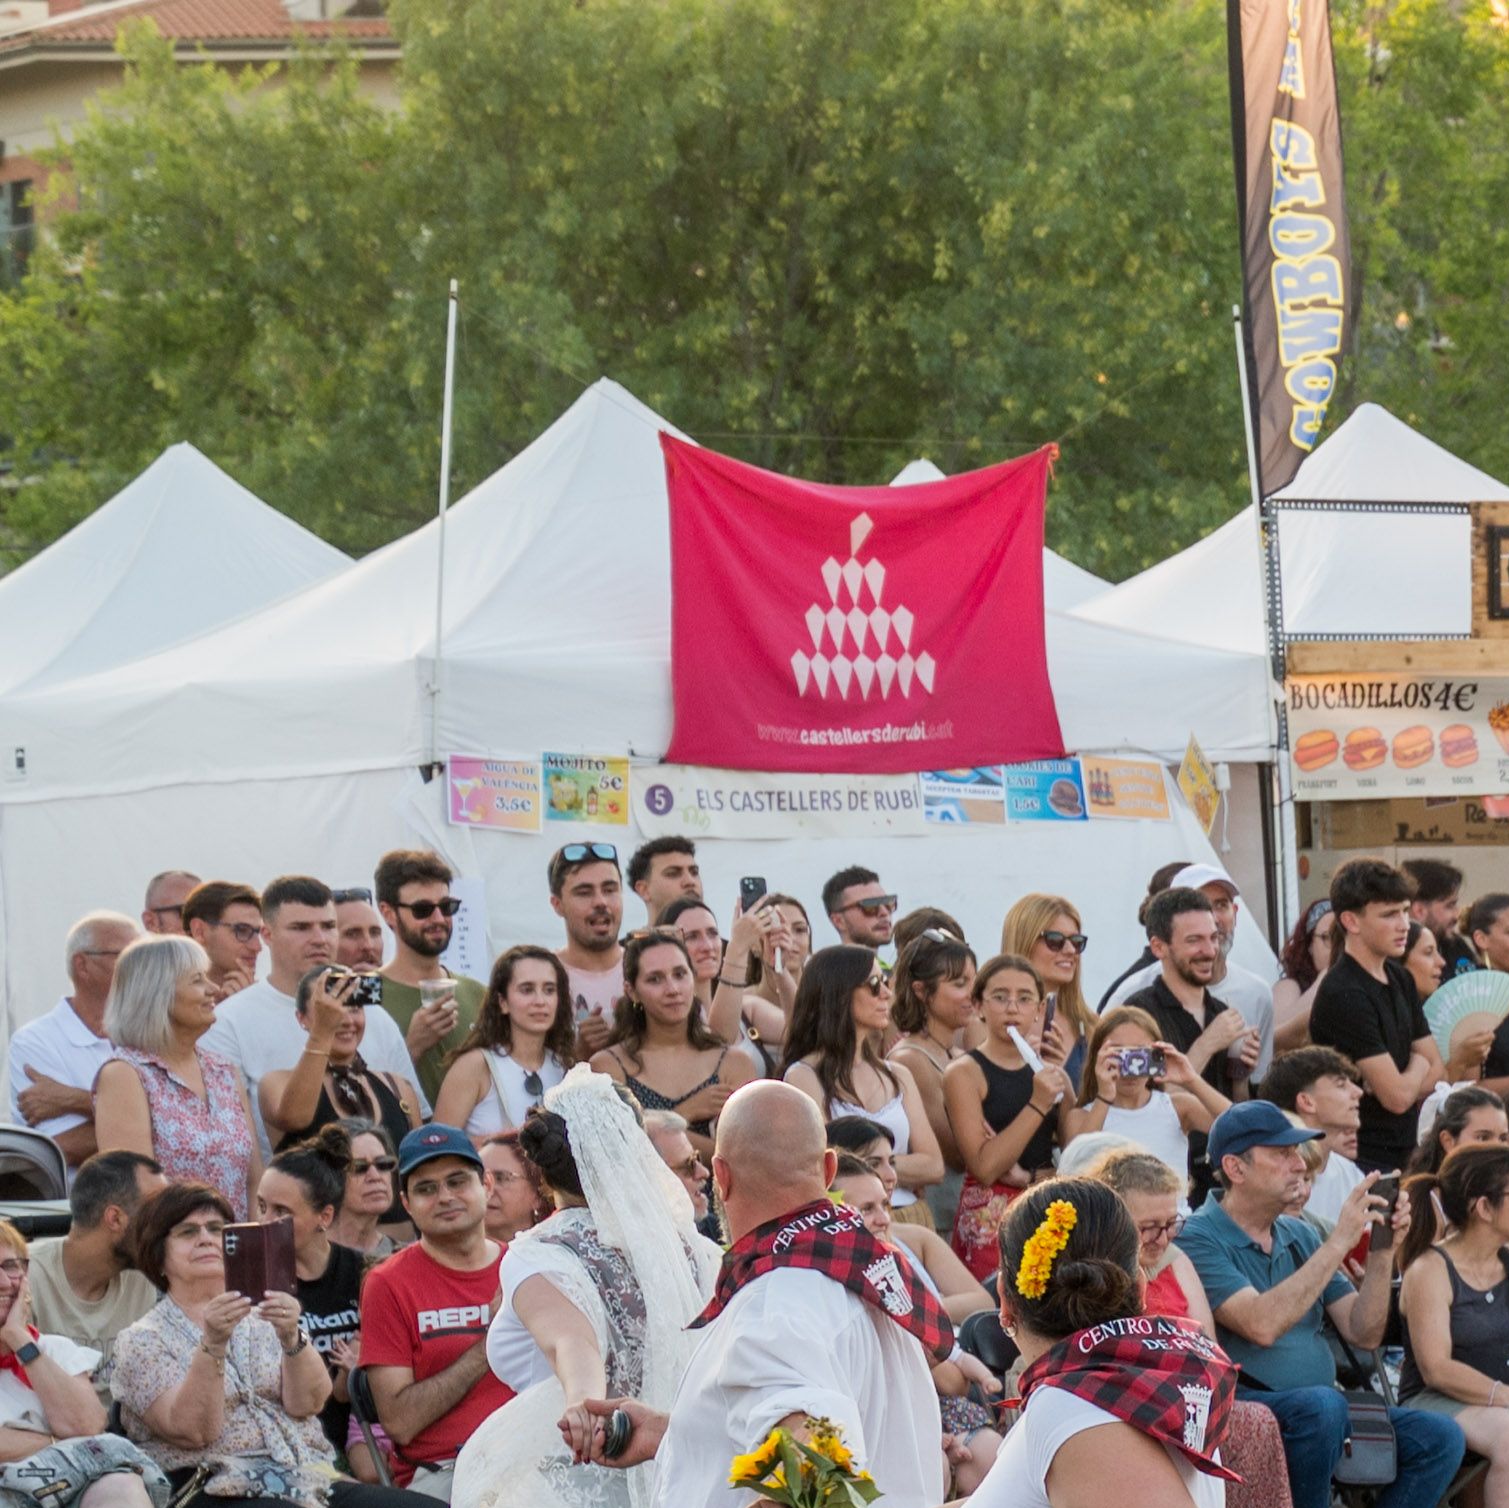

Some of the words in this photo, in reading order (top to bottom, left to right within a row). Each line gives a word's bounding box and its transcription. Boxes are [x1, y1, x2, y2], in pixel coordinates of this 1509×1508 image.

[1269, 117, 1344, 452] COWBOYS
[1290, 681, 1434, 711] BOCADILLOS
[1434, 682, 1479, 713] 4€
[521, 763, 537, 777] DE
[545, 755, 607, 772] MOJITO
[599, 775, 624, 791] 5€
[495, 796, 532, 813] 3,5€
[653, 789, 667, 811] 5
[695, 788, 725, 812] ELS
[729, 788, 843, 812] CASTELLERS
[847, 789, 871, 812] DE
[873, 784, 921, 812] RUBÍ
[1078, 1316, 1153, 1354] CENTRO
[1141, 1338, 1174, 1351] DE
